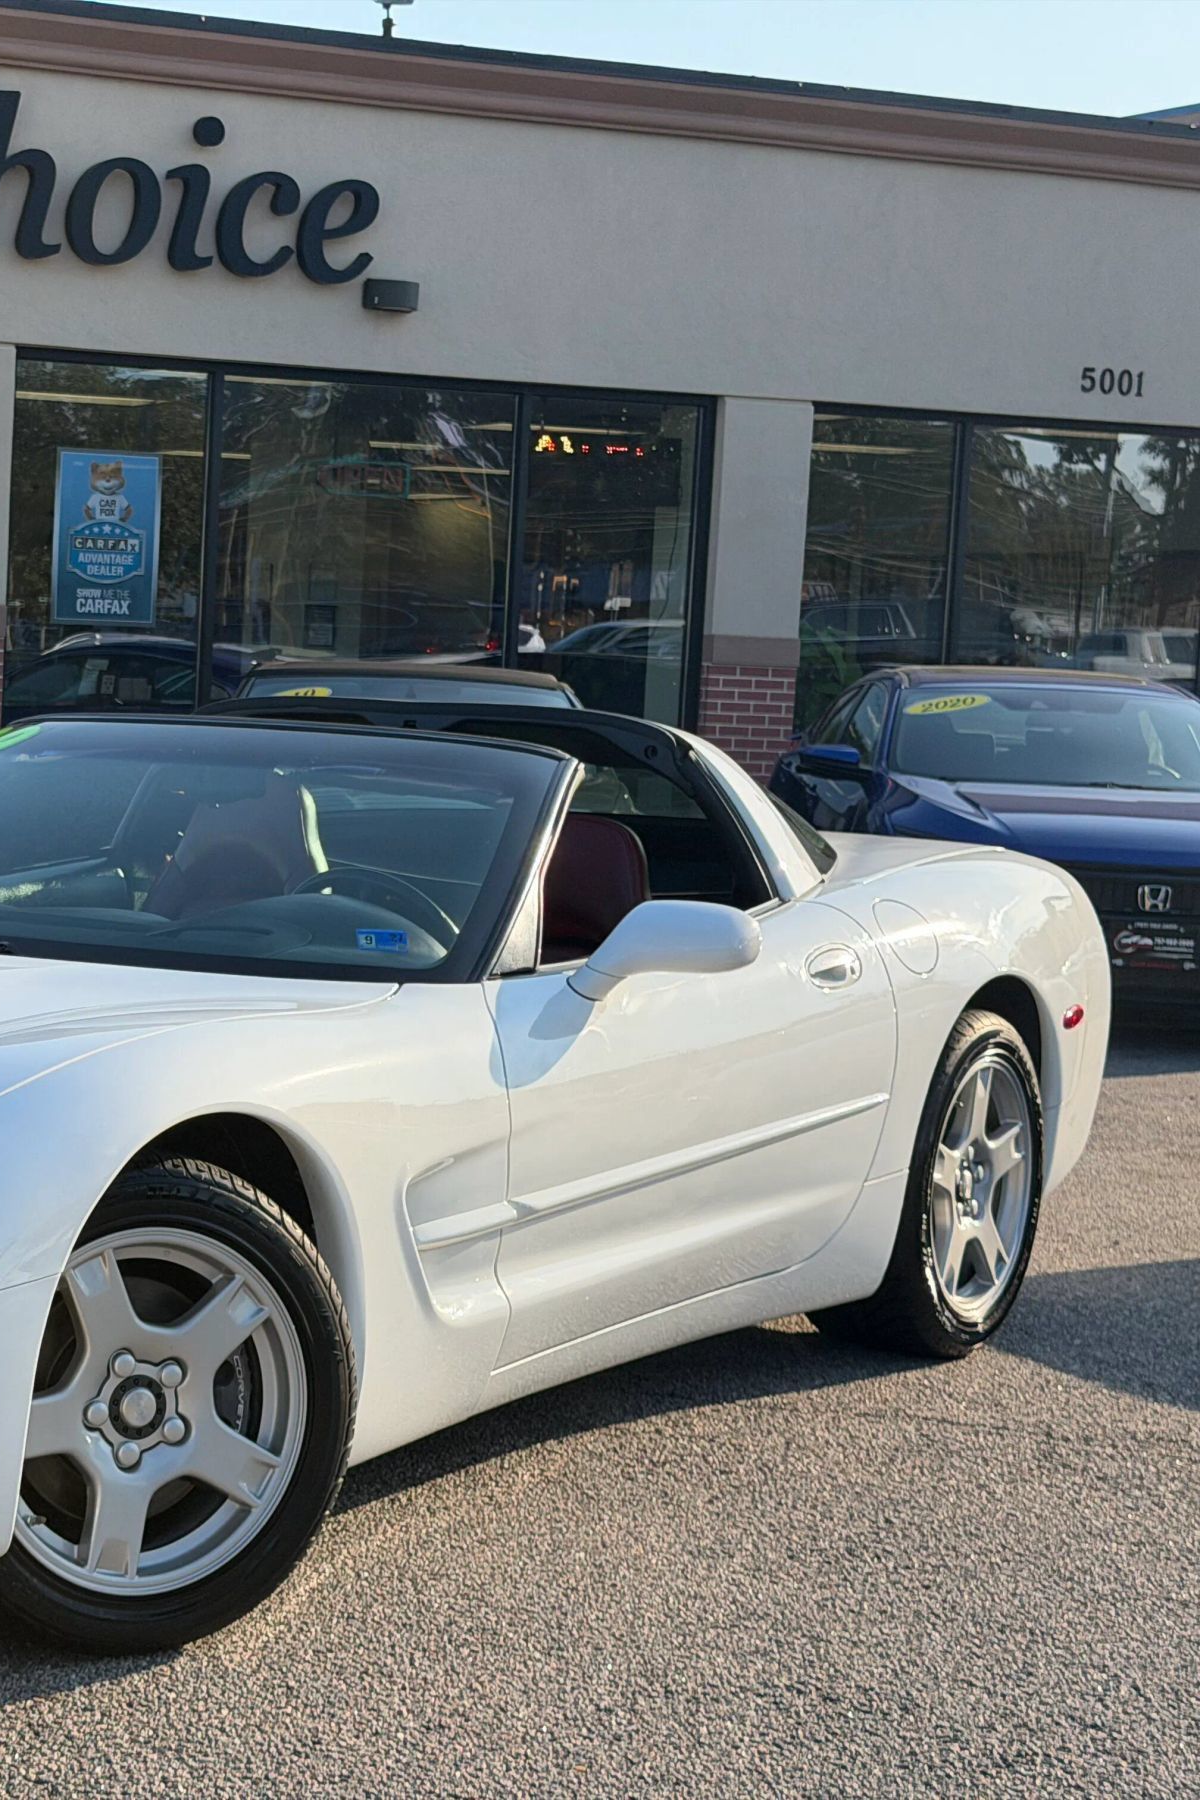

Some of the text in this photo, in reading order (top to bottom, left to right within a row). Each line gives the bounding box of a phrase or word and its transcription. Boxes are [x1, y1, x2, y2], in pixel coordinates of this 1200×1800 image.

[1080, 367, 1143, 397] 5001
[99, 499, 117, 508] CAR
[100, 508, 116, 517] FOX
[75, 538, 138, 552] CARFAX
[78, 552, 134, 565] ADVANTAGE
[87, 565, 124, 576] DEALER
[76, 588, 131, 601] SHOW ME THE
[76, 598, 131, 615] CARFAX
[921, 697, 976, 713] 2020
[233, 1355, 245, 1433] CORVET
